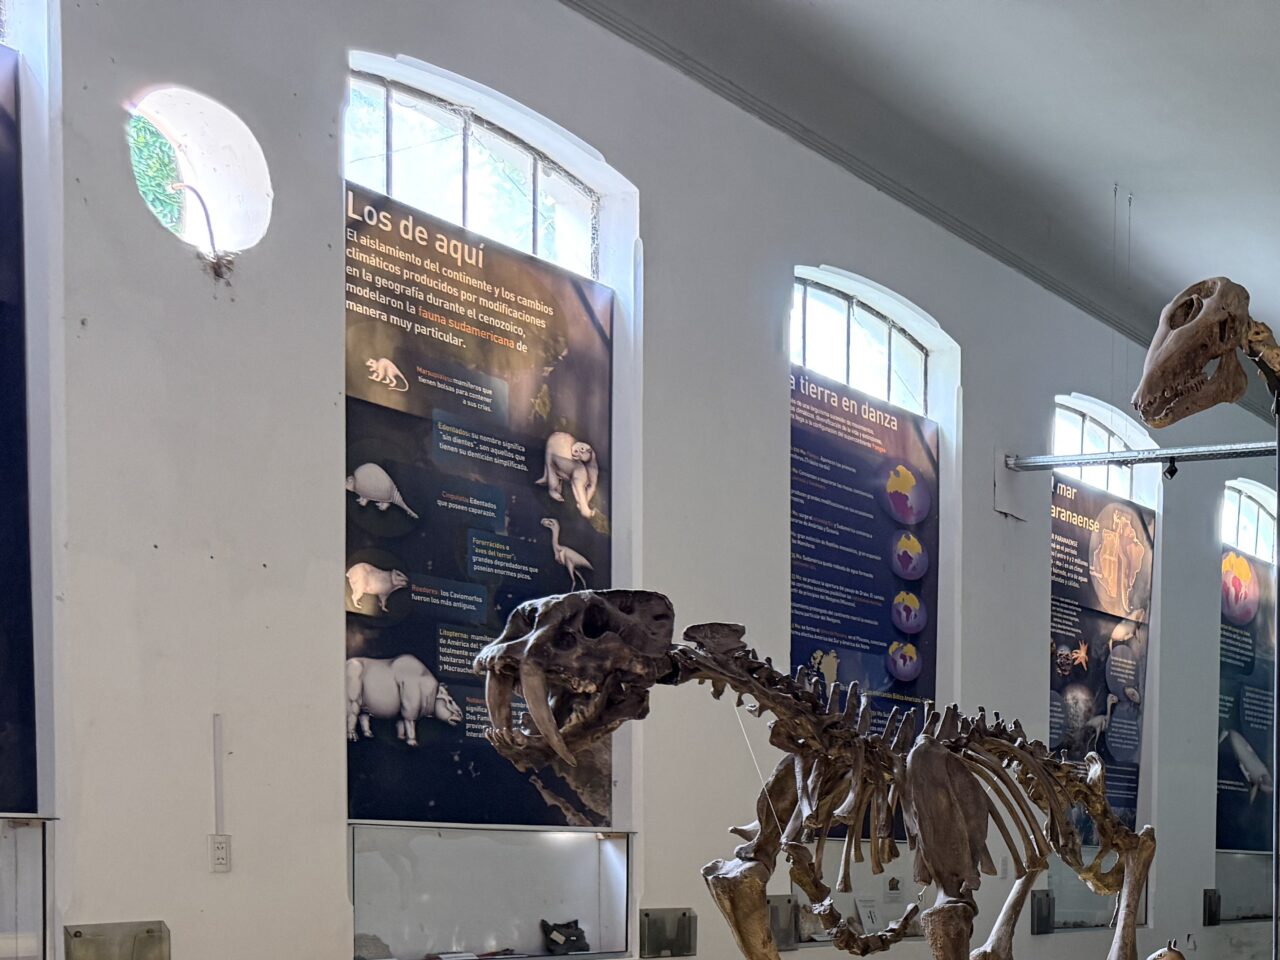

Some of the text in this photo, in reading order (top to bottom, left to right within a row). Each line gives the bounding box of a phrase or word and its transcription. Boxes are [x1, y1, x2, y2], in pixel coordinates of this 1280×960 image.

[347, 190, 485, 268] Los de aquí
[346, 228, 554, 316] El aislamiento del continente y los cambios
[346, 246, 546, 329] climáticos producidos por modificaciones
[346, 265, 526, 338] en la geografía durante el cenozoico,
[346, 282, 528, 353] modelaron la fauna sudamericana de
[346, 300, 467, 348] manera muy particular.
[800, 375, 838, 408] tierra
[841, 396, 858, 415] en
[861, 401, 898, 432] danza
[1051, 504, 1100, 533] aranaense
[1057, 482, 1078, 500] mar
